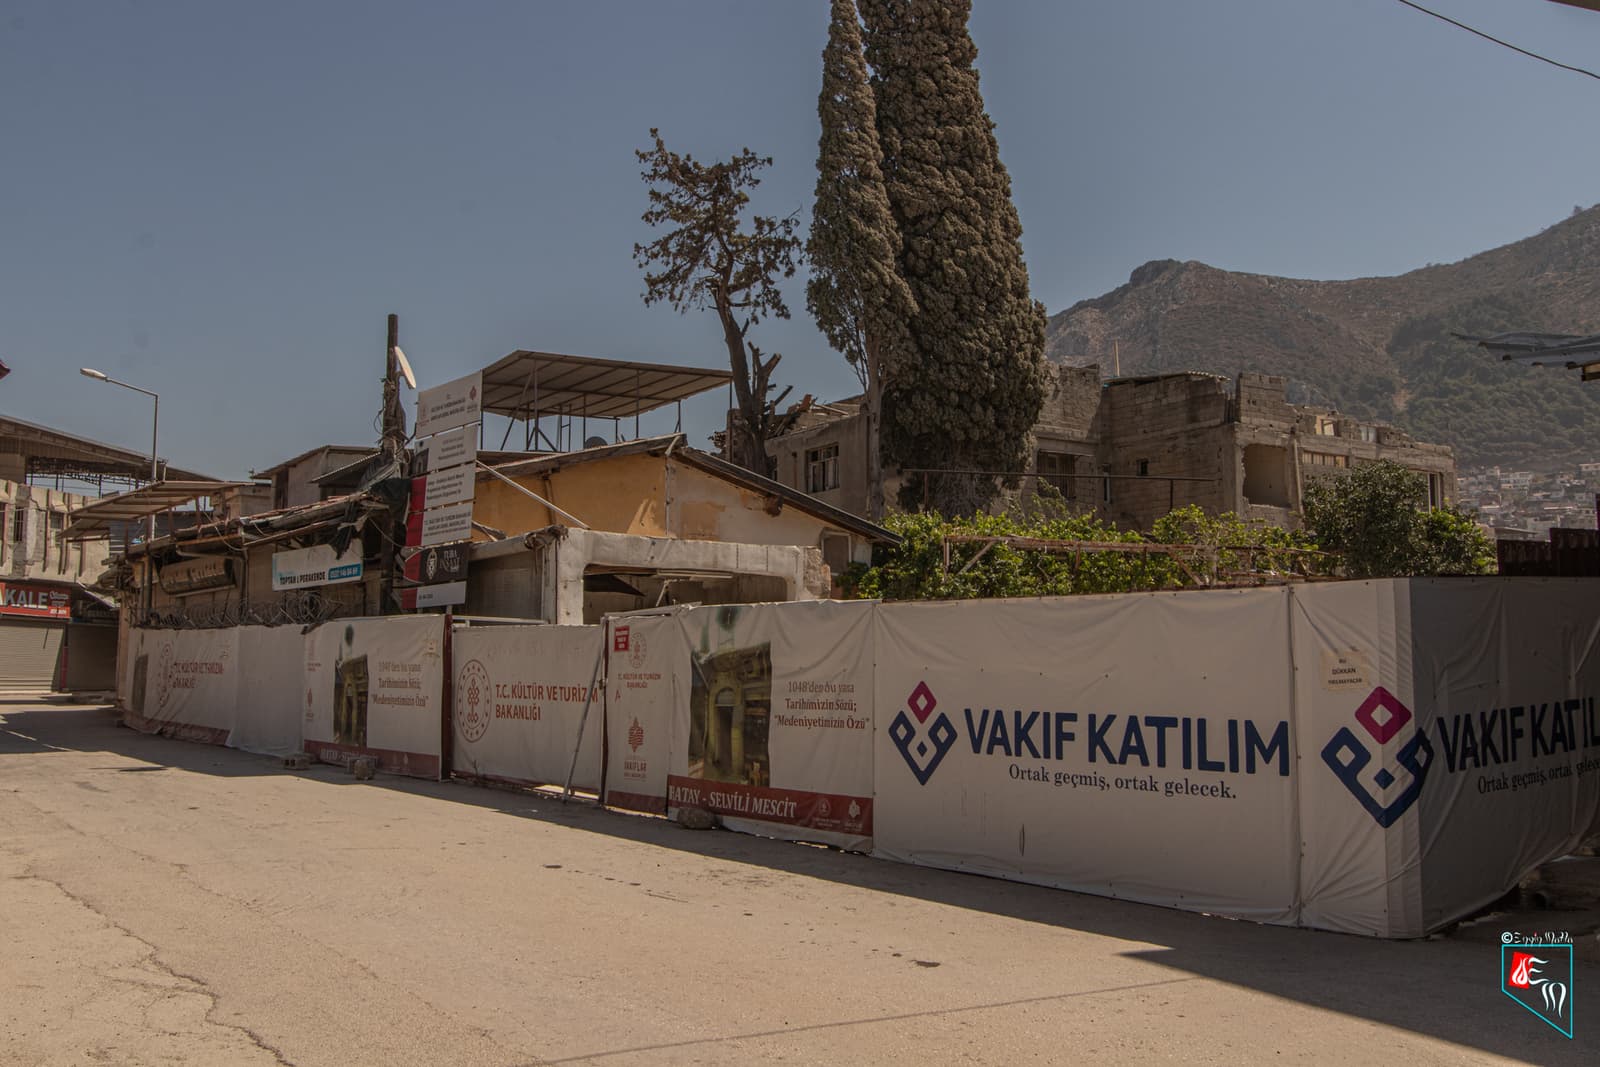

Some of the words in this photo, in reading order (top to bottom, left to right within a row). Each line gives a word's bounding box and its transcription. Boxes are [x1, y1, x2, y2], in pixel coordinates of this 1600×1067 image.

[6, 588, 49, 609] KALE
[496, 684, 510, 699] T.C.
[511, 681, 544, 701] KÜLTÜR
[545, 685, 558, 701] VE
[496, 703, 541, 721] BAKANLIĞI
[785, 698, 833, 711] Tarihimizin
[964, 708, 1078, 760] VAKIF
[1087, 713, 1289, 777] KATILIM
[1437, 706, 1525, 774] VAKIF
[1009, 763, 1050, 782] Ortak
[1054, 770, 1110, 791] geçmiş,
[1115, 775, 1159, 793] ortak
[1164, 778, 1237, 799] gelecek.
[1478, 771, 1510, 794] Ortak
[709, 791, 750, 812] SELVİLİ
[752, 796, 797, 818] MESCİT
